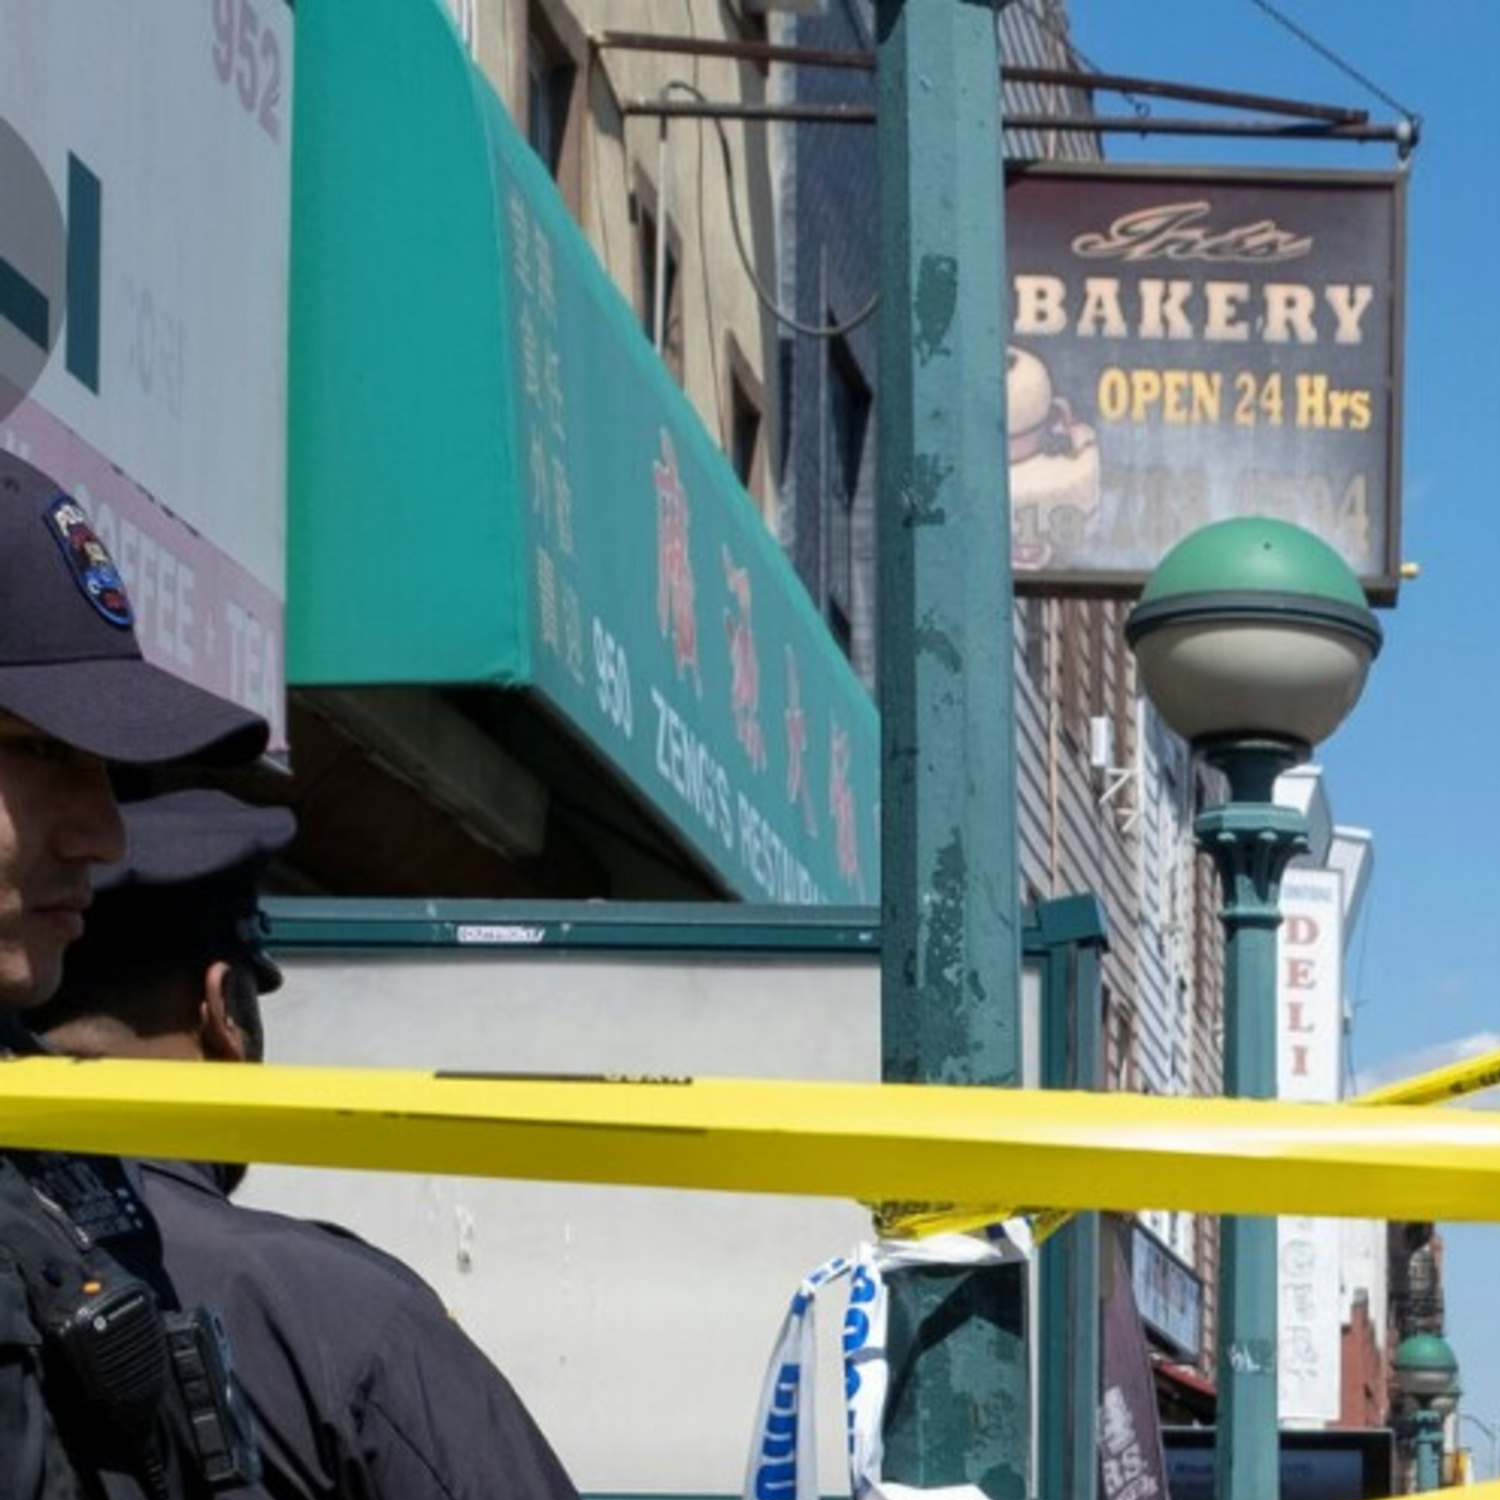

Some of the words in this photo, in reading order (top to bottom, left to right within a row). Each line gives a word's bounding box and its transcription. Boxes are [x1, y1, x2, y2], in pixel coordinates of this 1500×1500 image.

[212, 0, 281, 144] 952
[1012, 274, 1374, 346] BAKERY
[1099, 366, 1223, 427] OPEN
[1234, 372, 1284, 426] 24
[1294, 373, 1371, 431] Hrs
[593, 616, 633, 741] 950
[1286, 913, 1320, 1077] DELI
